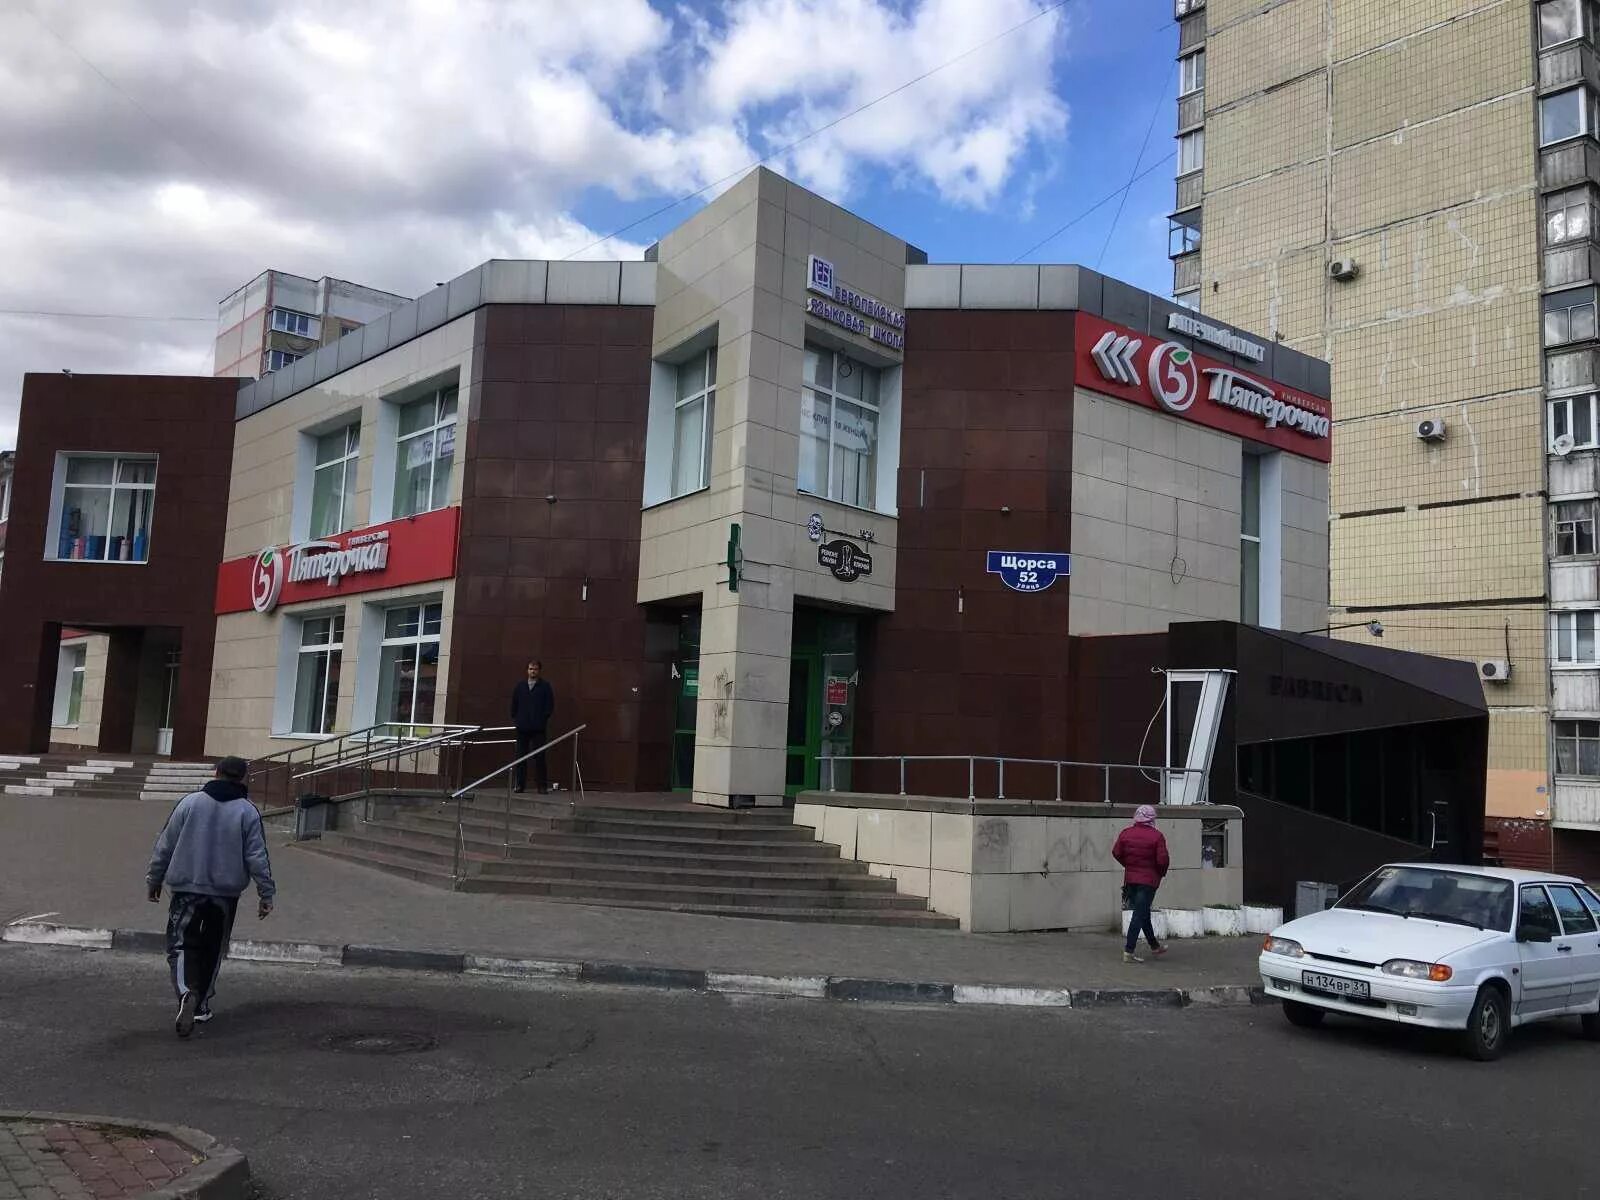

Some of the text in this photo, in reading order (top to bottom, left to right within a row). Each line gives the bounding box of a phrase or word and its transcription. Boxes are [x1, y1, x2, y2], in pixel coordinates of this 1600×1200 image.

[808, 298, 905, 350] ЯЗЫКОВАЯ ШКОЛА
[1202, 367, 1330, 438] Пятерочка
[286, 540, 390, 586] Пятерочка
[1001, 555, 1057, 571] Щорса
[1019, 571, 1038, 583] 52
[1016, 582, 1040, 590] улица
